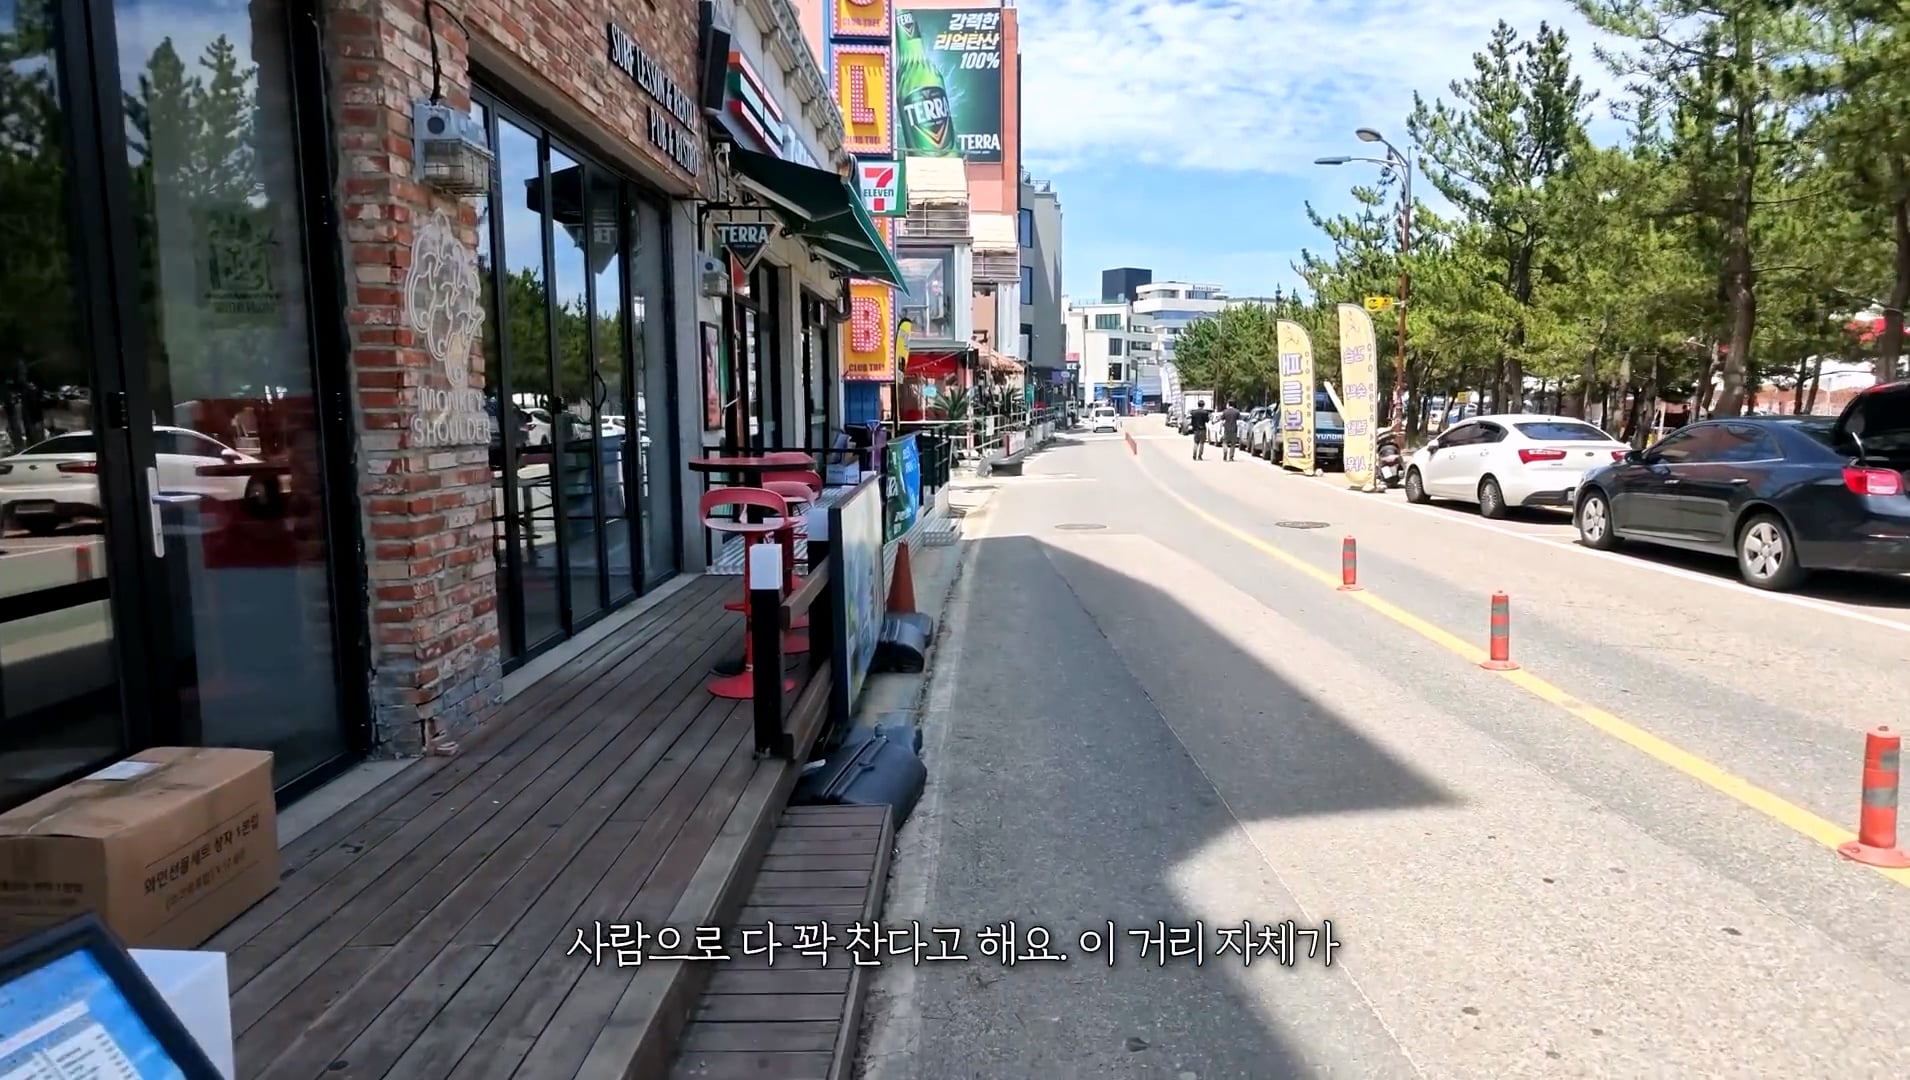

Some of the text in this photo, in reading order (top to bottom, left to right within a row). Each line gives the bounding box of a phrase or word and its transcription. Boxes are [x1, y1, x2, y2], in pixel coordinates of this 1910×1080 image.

[949, 12, 1000, 31] 강력한
[933, 32, 1000, 51] 리얼탄산
[610, 22, 637, 77] SURF
[636, 46, 666, 105] LESSON
[960, 51, 1000, 70] 100%
[904, 96, 950, 127] TERRA
[650, 107, 667, 151] PUB
[675, 130, 699, 177] BISTRO
[957, 133, 1000, 150] TERRA
[864, 167, 894, 211] 7
[718, 225, 769, 244] TERRA
[417, 386, 482, 412] MONKEY
[412, 416, 492, 443] SHOULDER
